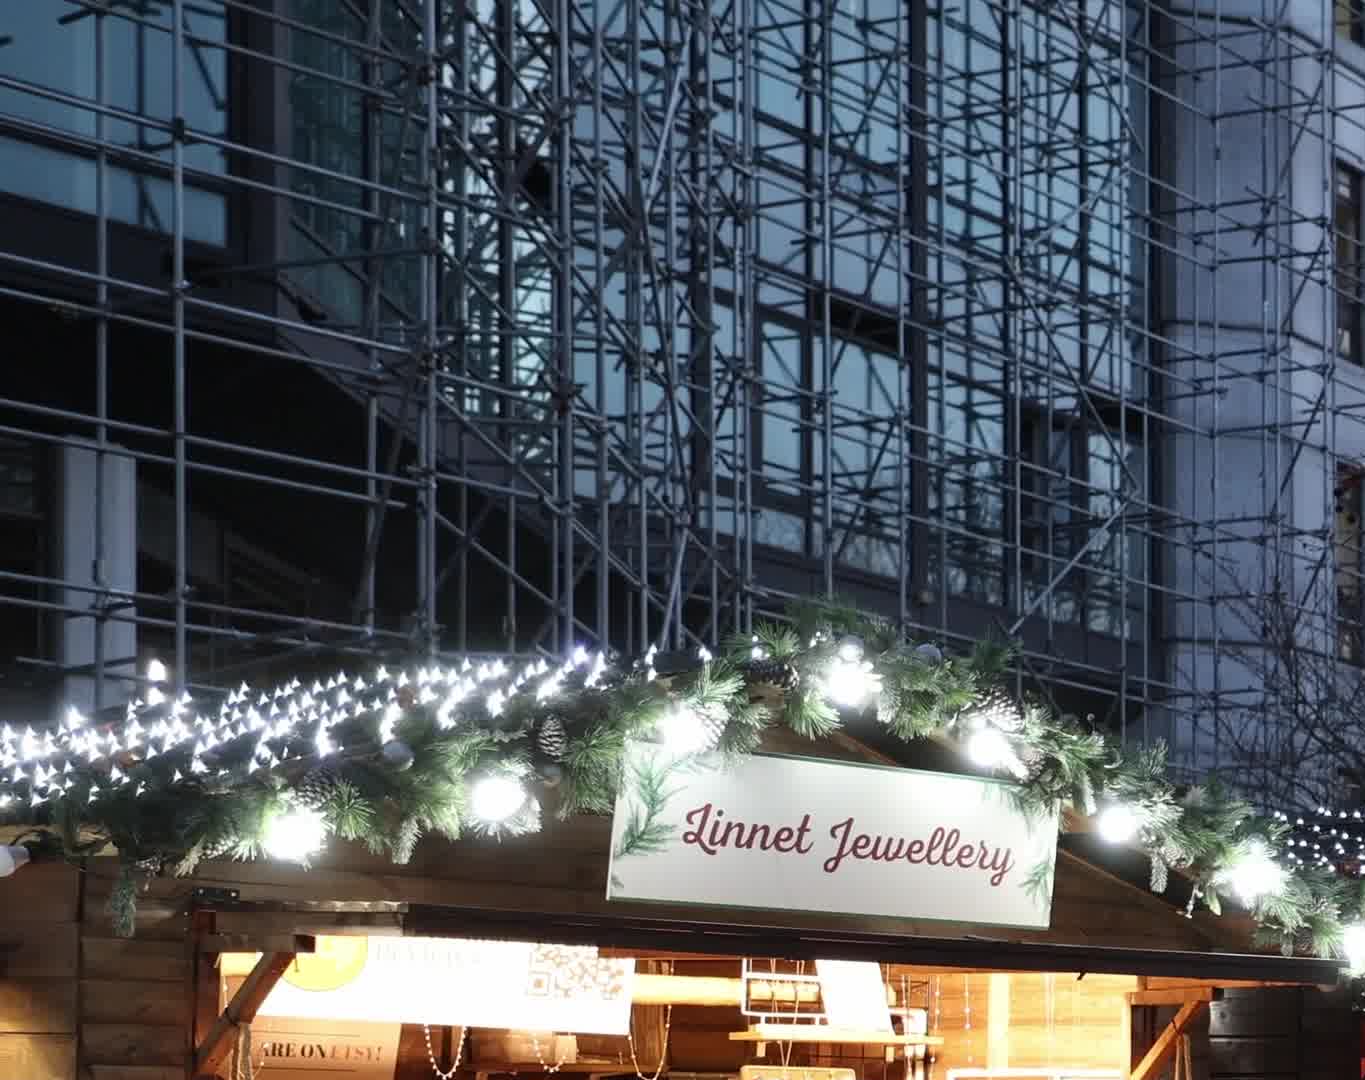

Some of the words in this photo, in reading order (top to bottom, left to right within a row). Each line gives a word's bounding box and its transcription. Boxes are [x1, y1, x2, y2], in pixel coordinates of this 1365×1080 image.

[683, 803, 813, 855] Linnet
[824, 818, 1015, 887] Jewellery
[301, 1044, 327, 1059] ON
